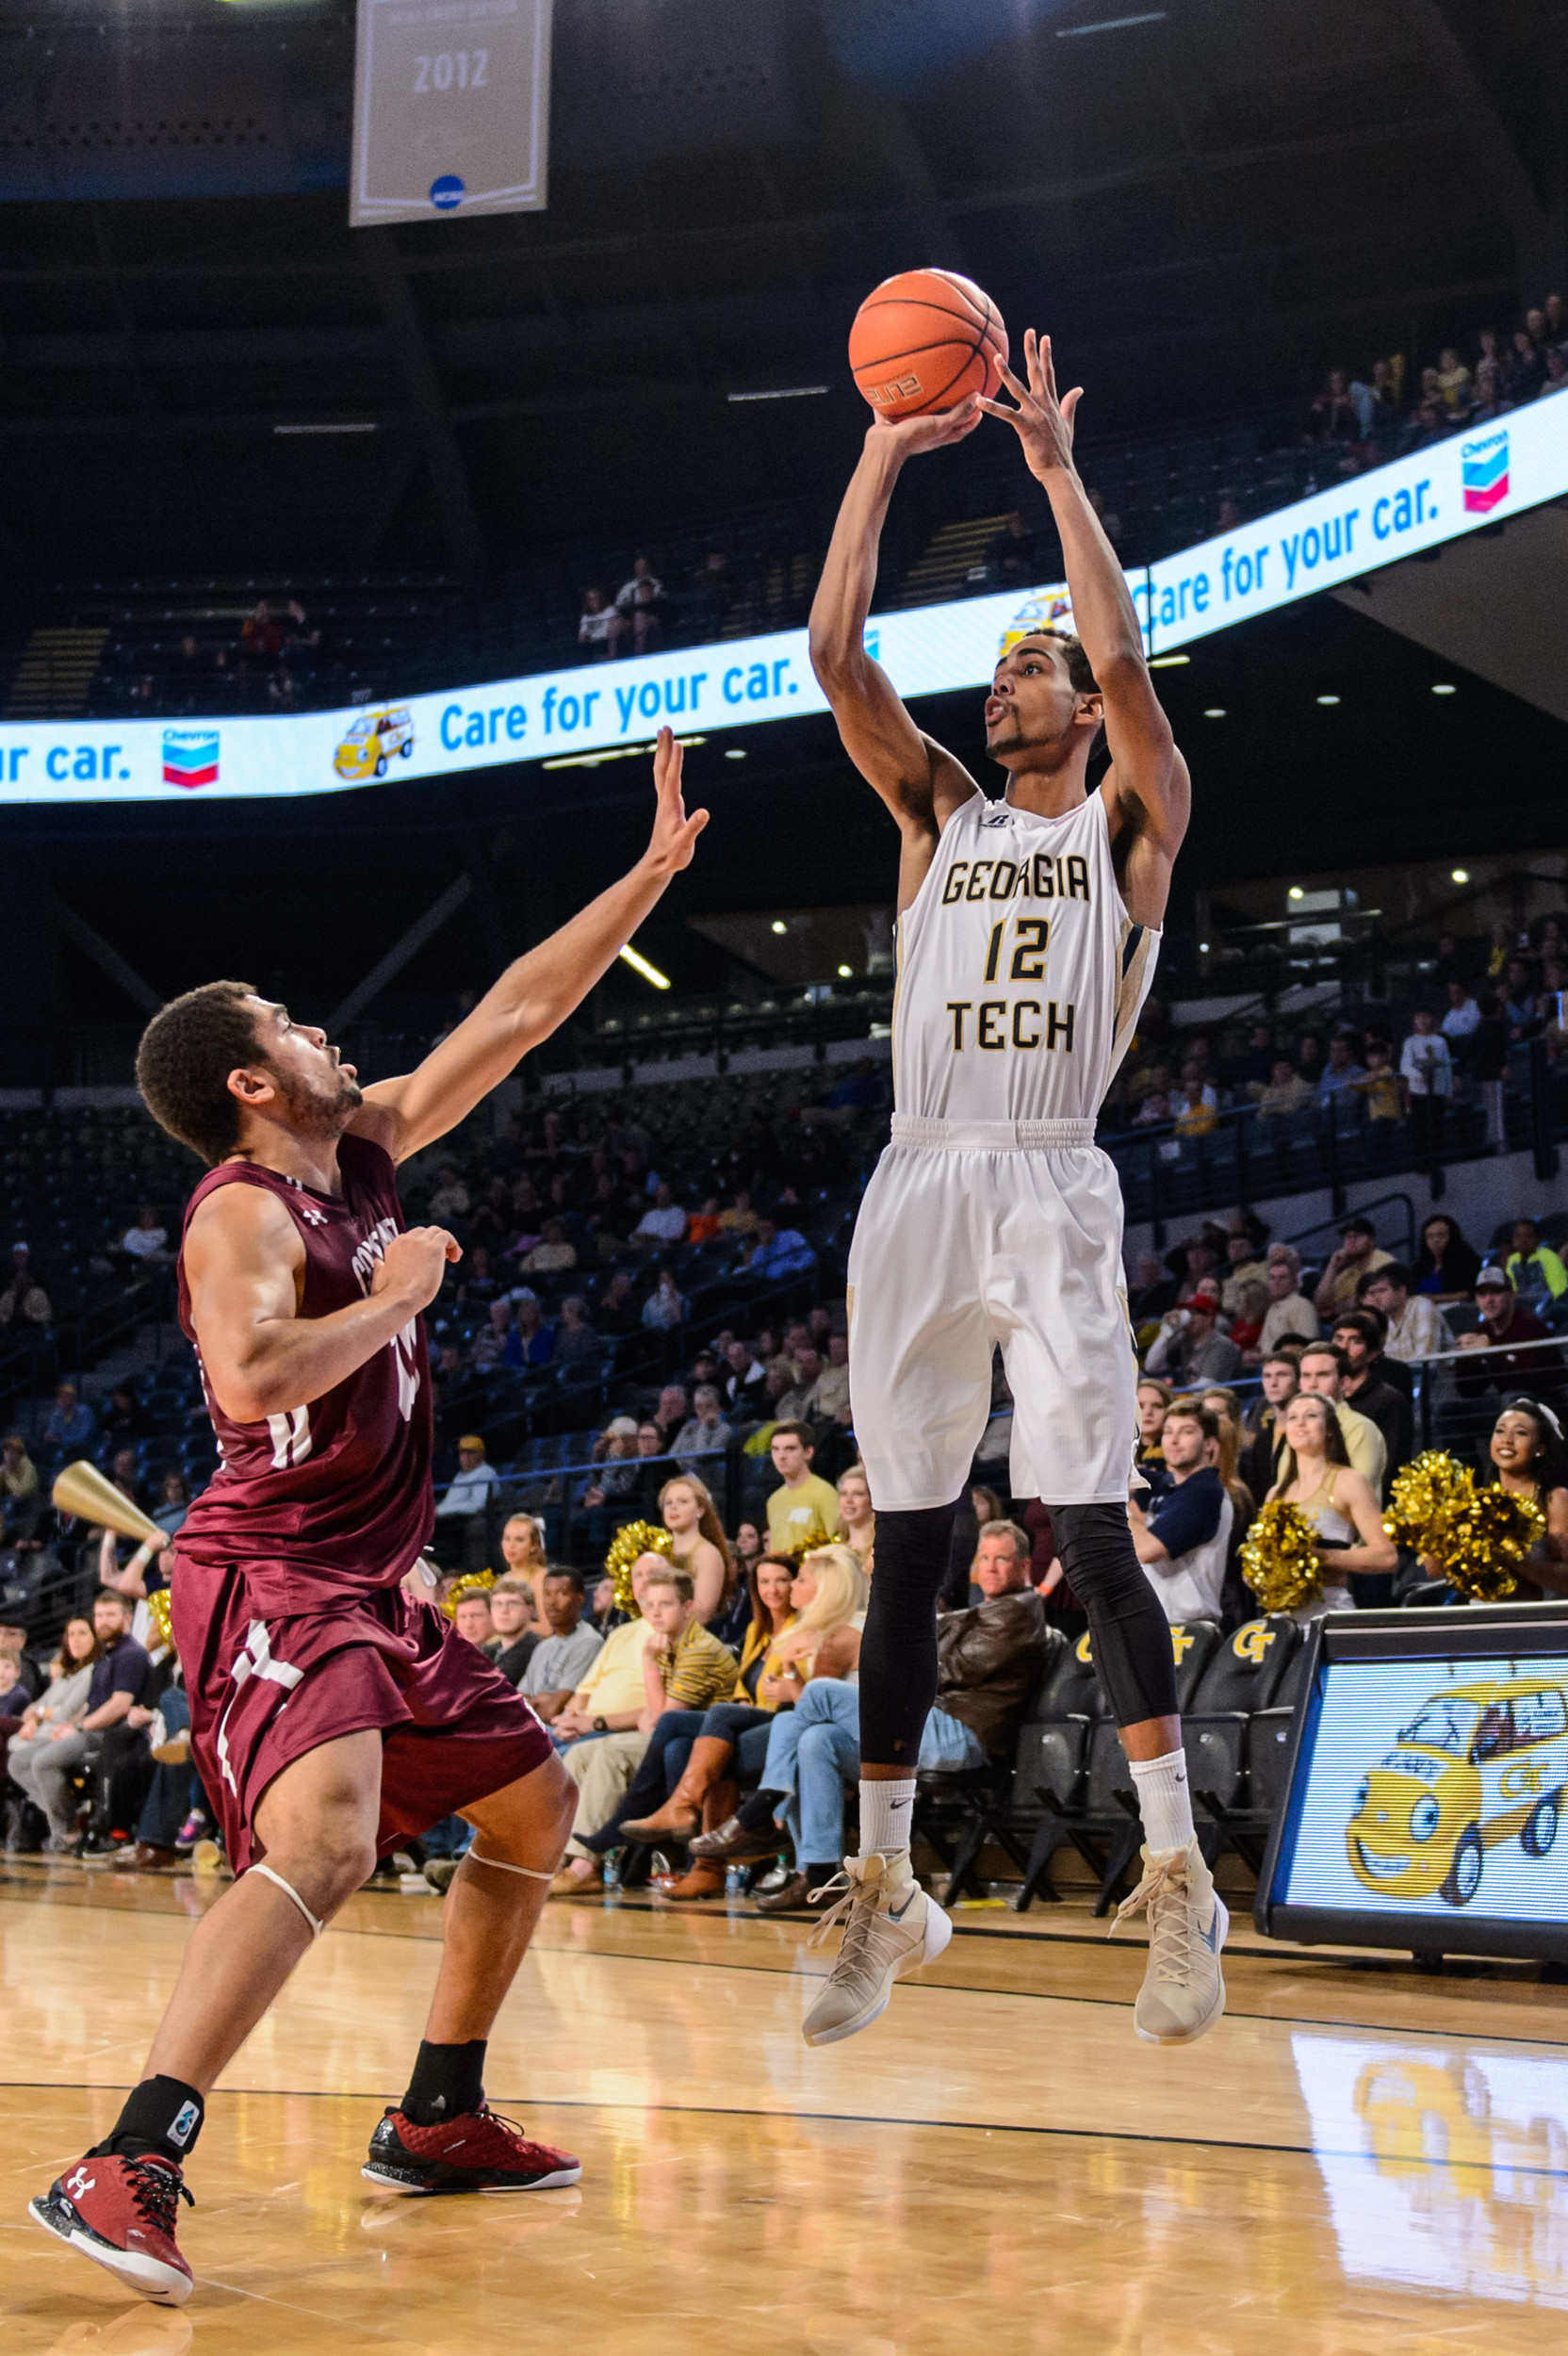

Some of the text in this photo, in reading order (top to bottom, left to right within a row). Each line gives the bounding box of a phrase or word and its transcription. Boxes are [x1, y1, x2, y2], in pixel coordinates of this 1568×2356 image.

[414, 50, 489, 92] 2012
[1221, 547, 1268, 602] for
[1281, 510, 1359, 589] your
[1372, 480, 1438, 540] car.
[439, 658, 798, 751] Care for your car.
[162, 728, 220, 741] Chevron
[45, 745, 130, 781] car.
[941, 853, 1091, 906] GEORGIA
[983, 917, 1052, 984] 12
[946, 999, 1075, 1053] TECH
[1232, 1623, 1277, 1664] GT
